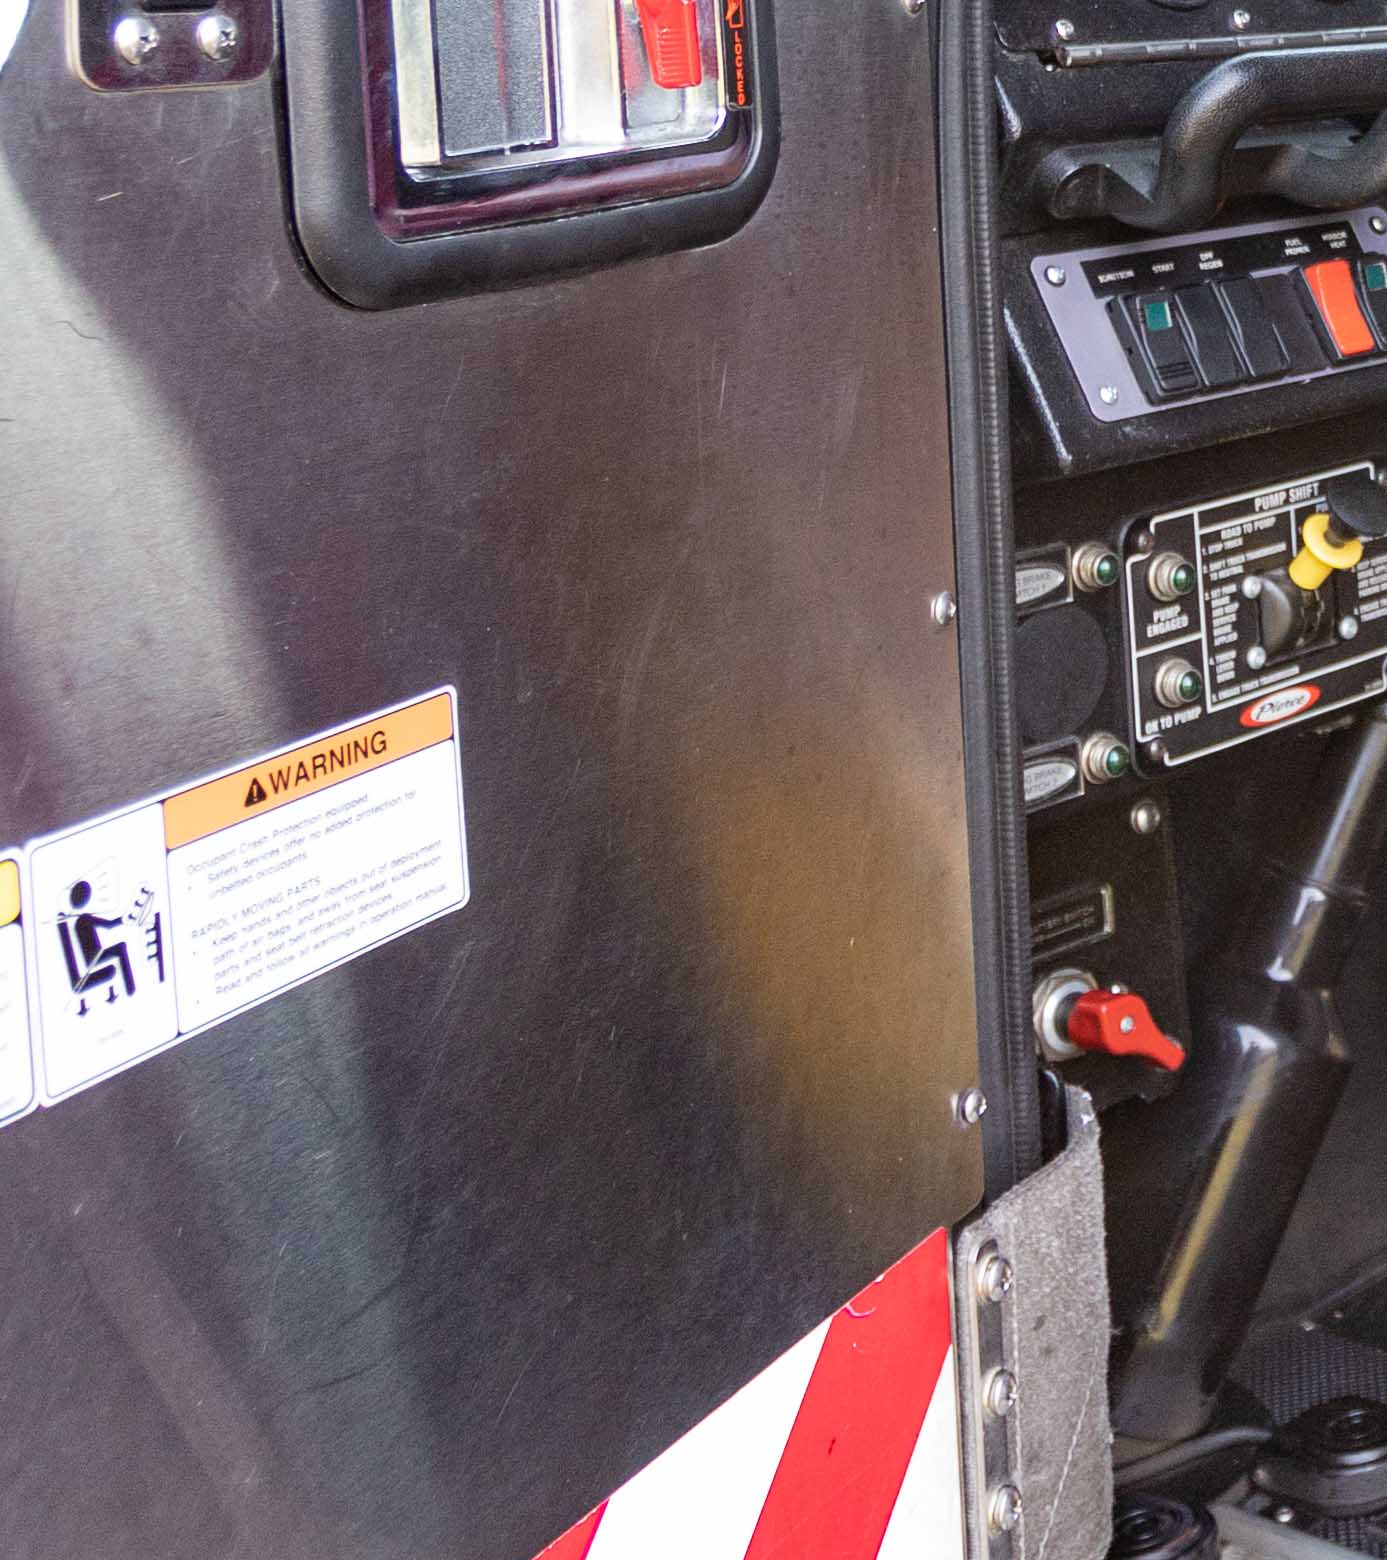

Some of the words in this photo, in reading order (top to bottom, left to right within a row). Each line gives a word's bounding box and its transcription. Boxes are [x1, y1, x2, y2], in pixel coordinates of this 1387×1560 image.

[734, 31, 745, 106] LOCKED
[1330, 240, 1346, 249] HEAT
[1098, 270, 1134, 283] IGNITION
[1151, 263, 1174, 274] START
[1199, 259, 1223, 271] REGEN
[1254, 490, 1286, 512] PUMP
[1289, 483, 1319, 502] SHIFT
[1253, 517, 1276, 531] PUMP
[1153, 605, 1180, 623] PUMP
[1147, 617, 1188, 637] ENGAGED
[1257, 694, 1305, 720] Pierce
[1145, 720, 1159, 734] OK
[1160, 717, 1171, 728] TO
[1173, 707, 1201, 727] PUMP
[269, 730, 387, 795] WARNING
[356, 797, 402, 822] protection
[273, 815, 321, 837] Protection
[390, 840, 442, 869] deployment
[242, 892, 283, 918] MOVING
[288, 877, 320, 896] PARTS
